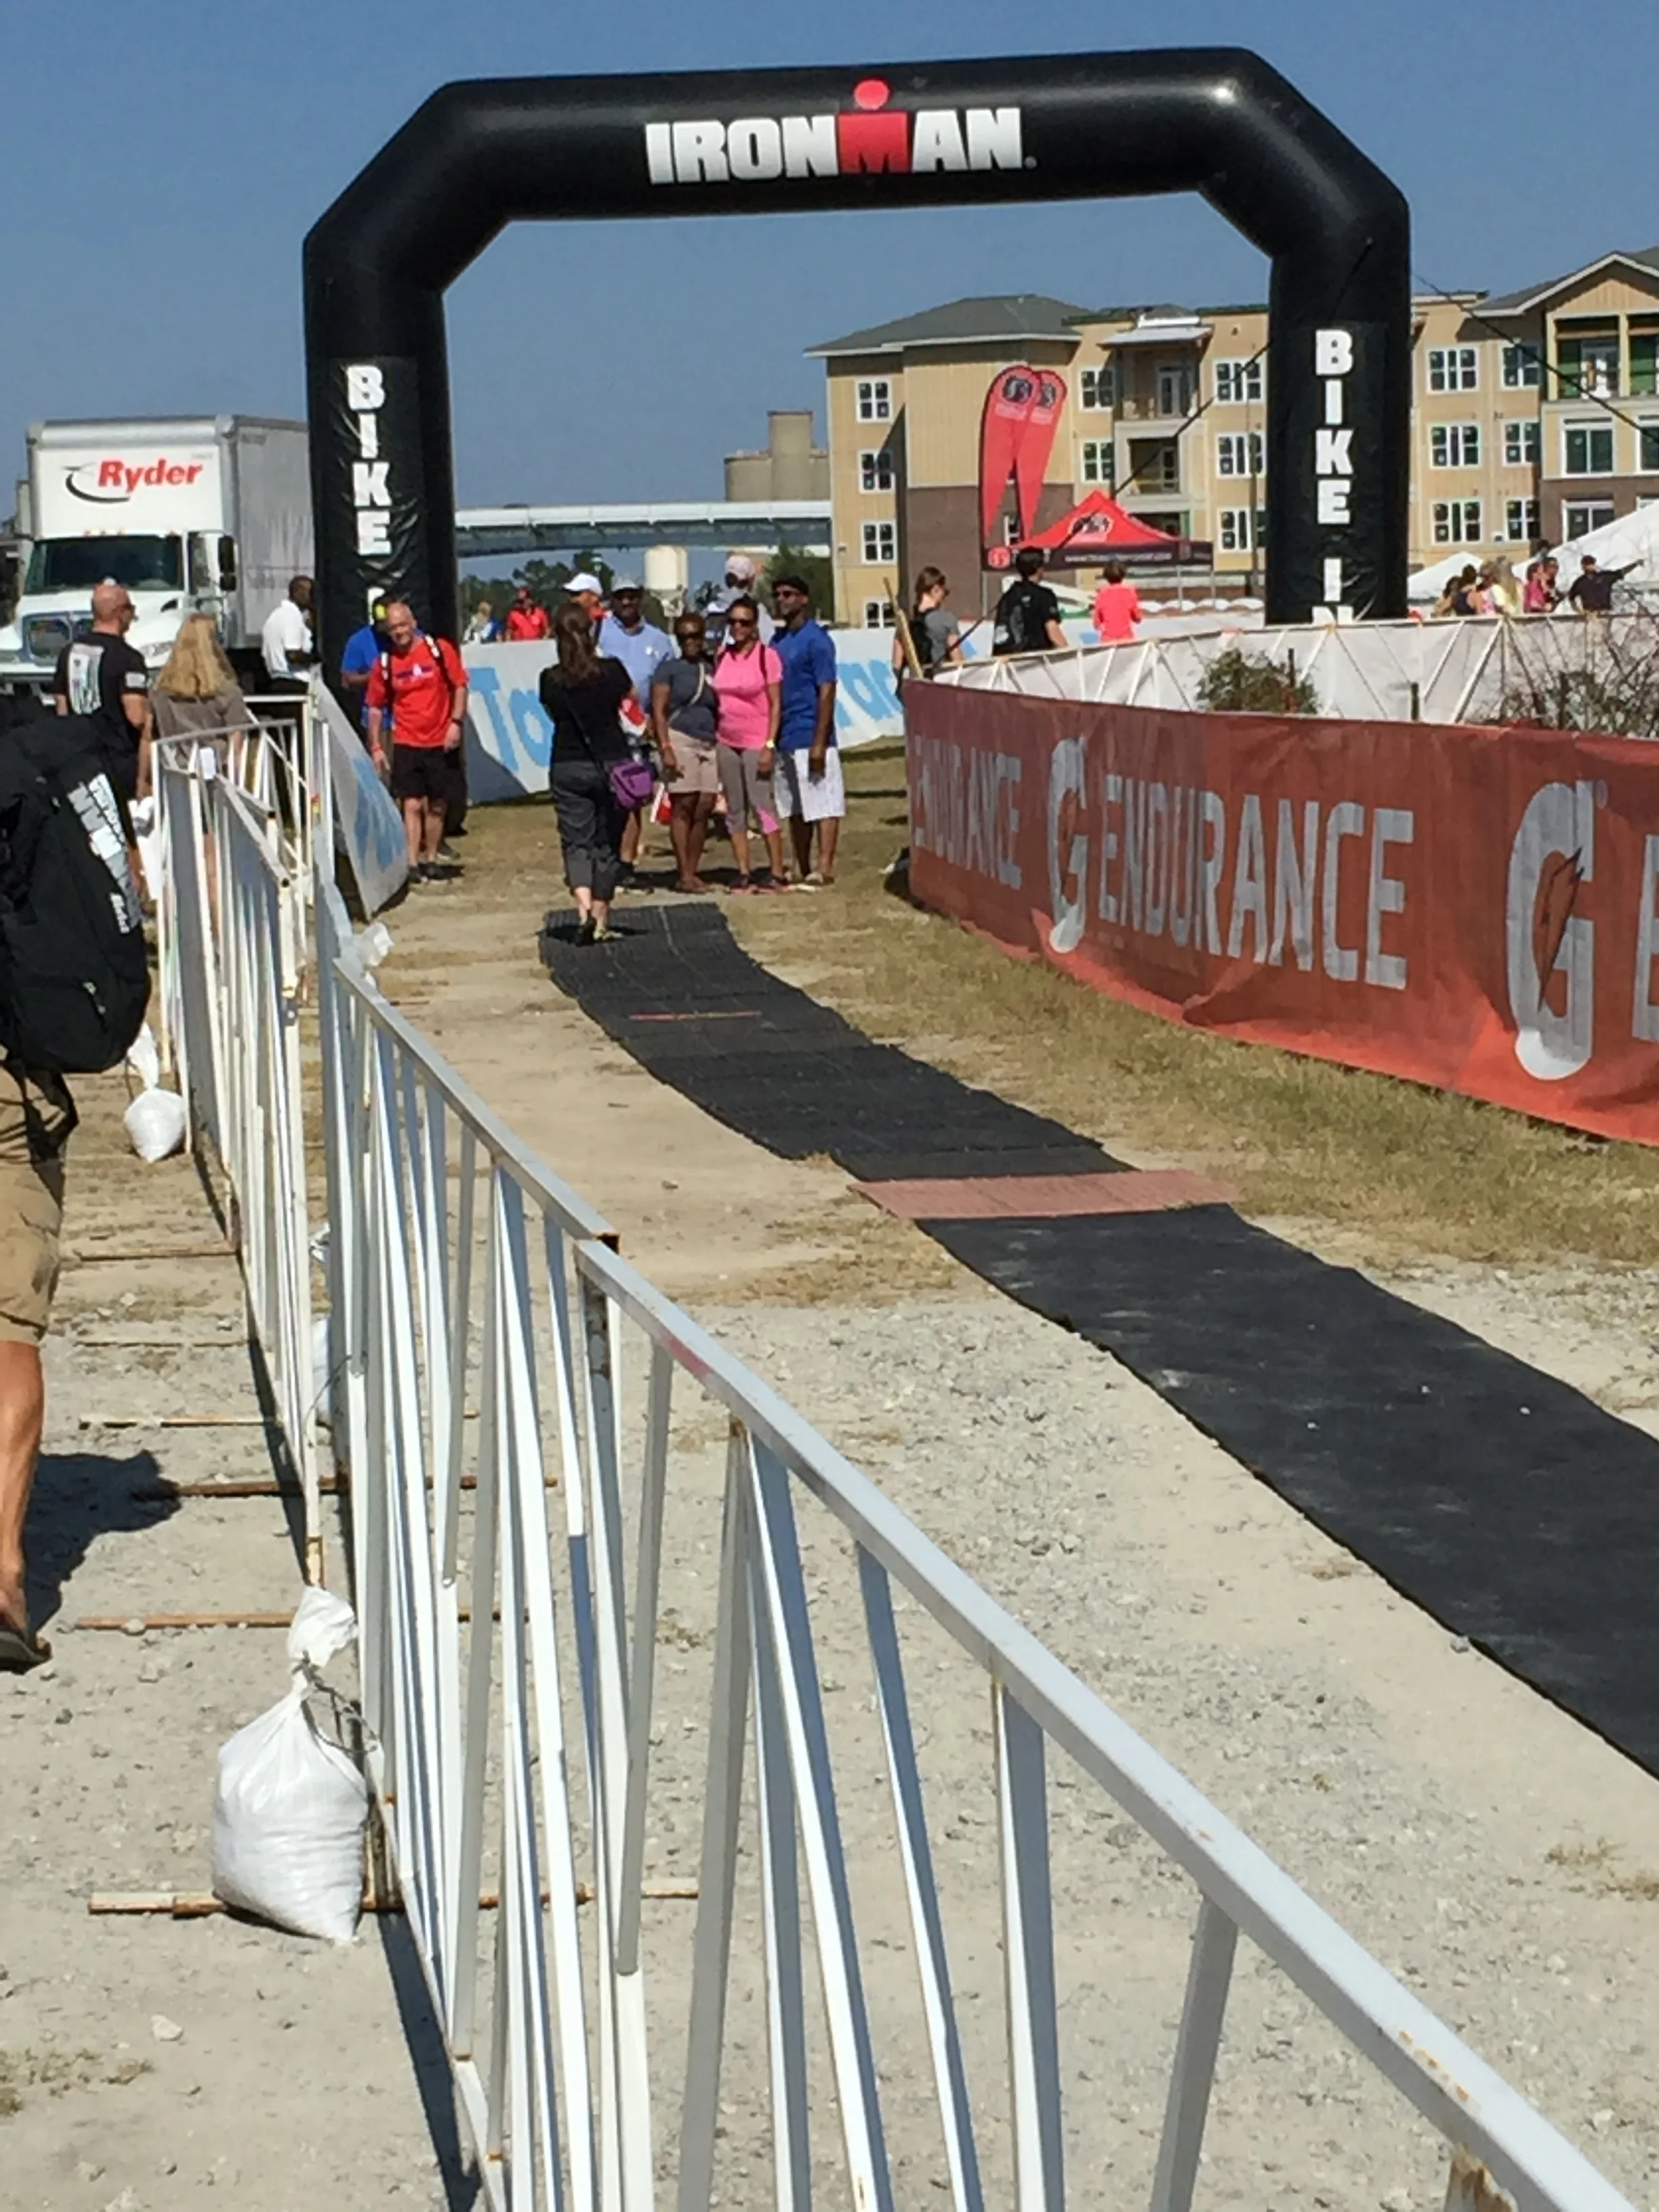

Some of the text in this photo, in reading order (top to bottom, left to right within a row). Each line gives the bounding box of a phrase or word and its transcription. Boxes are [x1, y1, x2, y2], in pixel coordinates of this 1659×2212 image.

[646, 79, 1022, 184] IRONMAN
[98, 458, 203, 494] Ryder
[347, 365, 392, 556] BIKE
[1315, 329, 1354, 525] BIKE
[1099, 774, 1414, 990] ENDURANCE
[1506, 780, 1593, 1081] G
